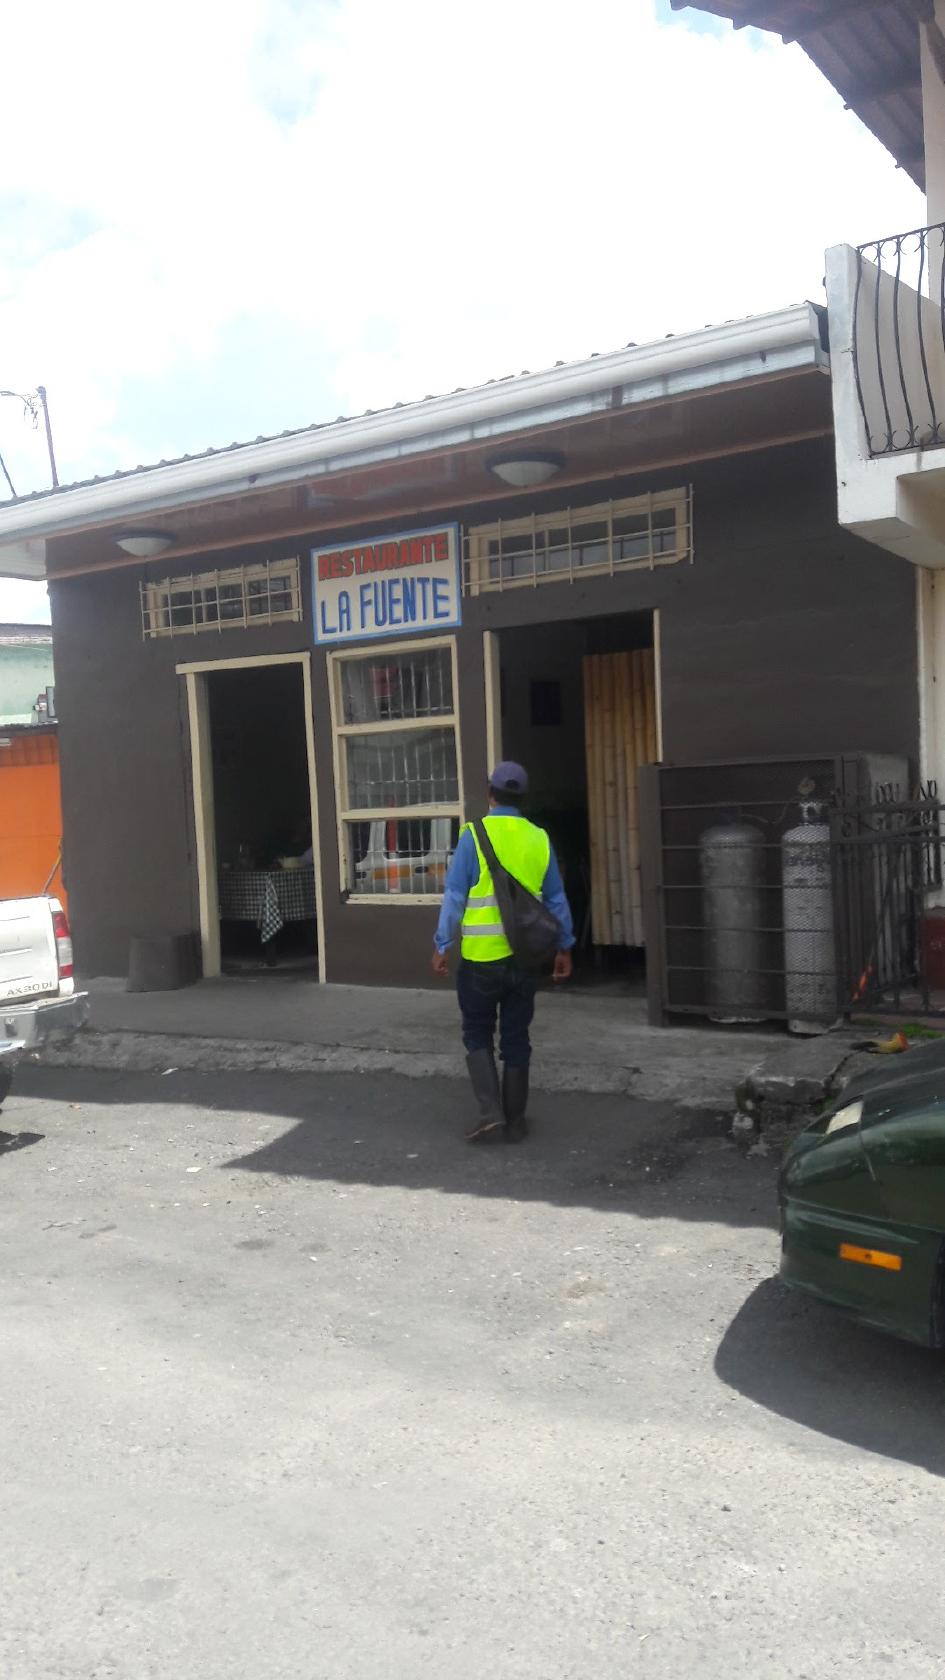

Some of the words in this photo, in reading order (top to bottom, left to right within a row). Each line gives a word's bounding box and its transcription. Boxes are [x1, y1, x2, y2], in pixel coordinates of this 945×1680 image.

[318, 532, 449, 581] RESTAURANTE
[321, 590, 351, 634] LA
[359, 577, 450, 629] FUENTE
